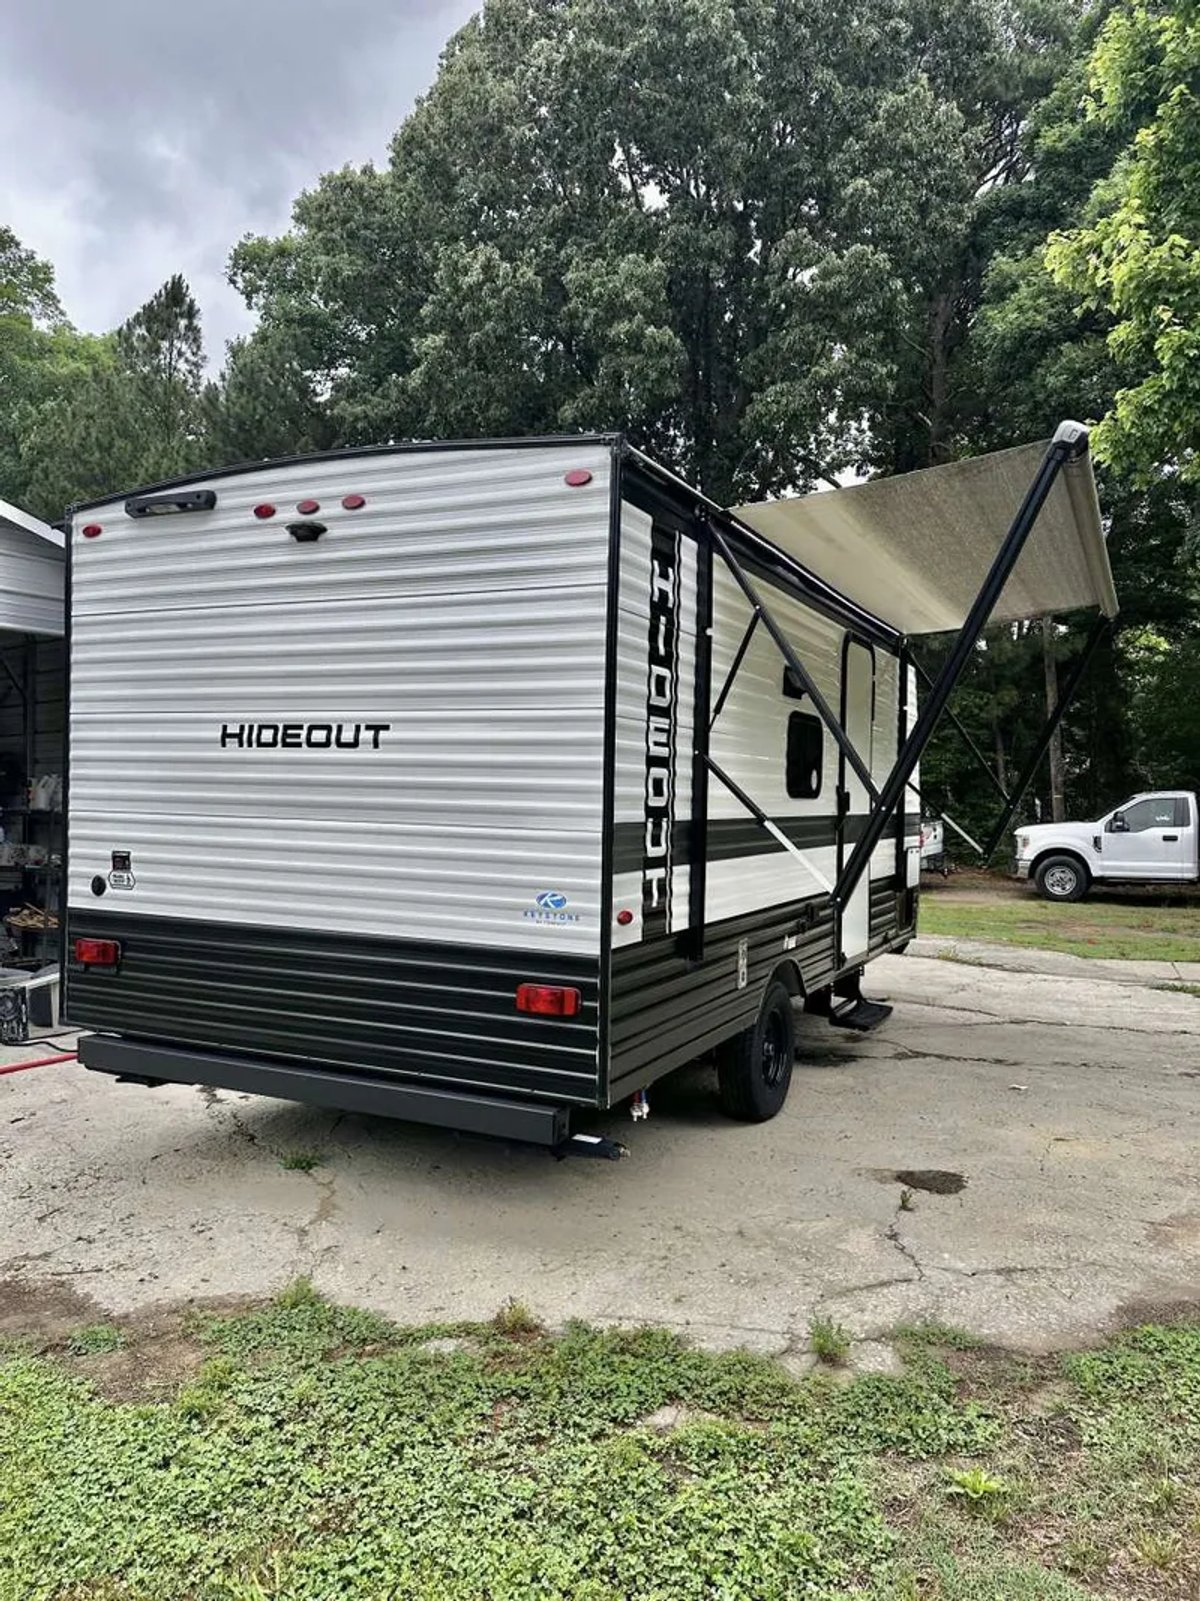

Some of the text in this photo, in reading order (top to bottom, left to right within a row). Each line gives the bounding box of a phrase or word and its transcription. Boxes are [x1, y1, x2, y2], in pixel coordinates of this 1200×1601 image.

[221, 724, 390, 749] HIDEOUT
[645, 559, 674, 907] HIDEOUT
[523, 910, 580, 921] KEYSTONE
